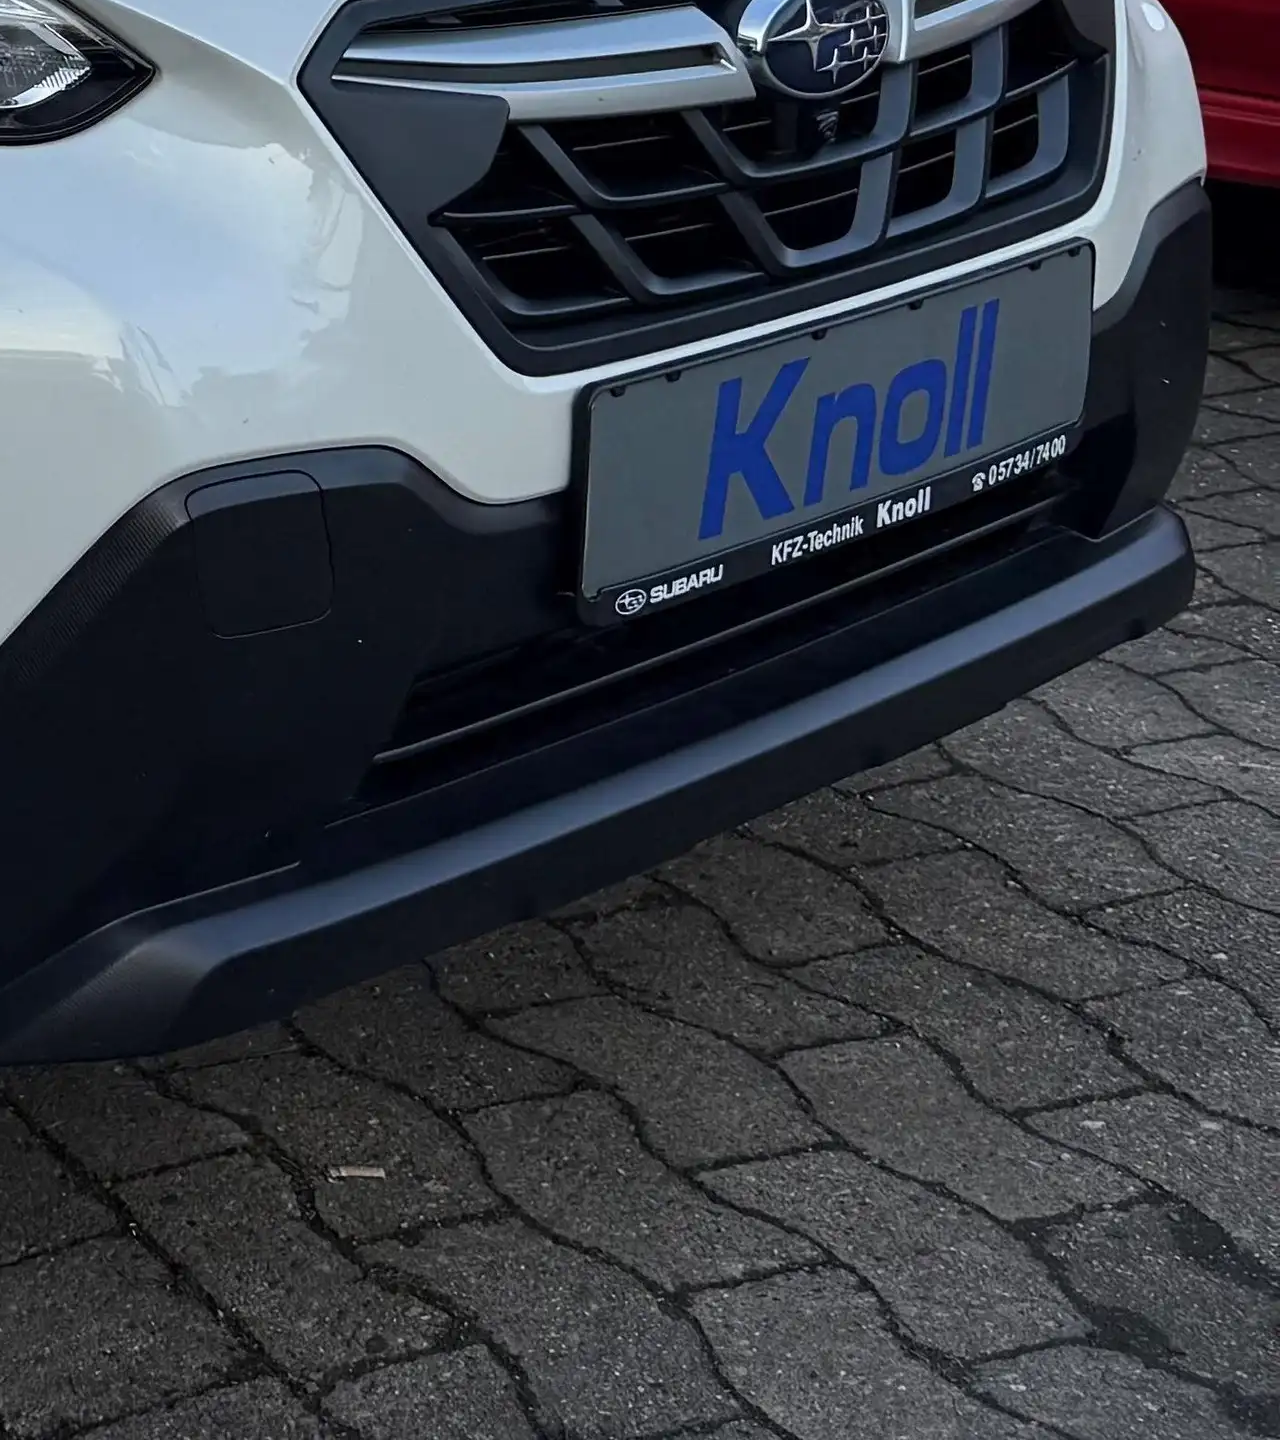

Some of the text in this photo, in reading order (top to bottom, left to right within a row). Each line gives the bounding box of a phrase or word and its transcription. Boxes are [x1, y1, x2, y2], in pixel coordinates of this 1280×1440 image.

[649, 434, 1067, 604] SUBARU KFZ-Technik Knoll 05734/7400
[698, 298, 1000, 541] Knoll
